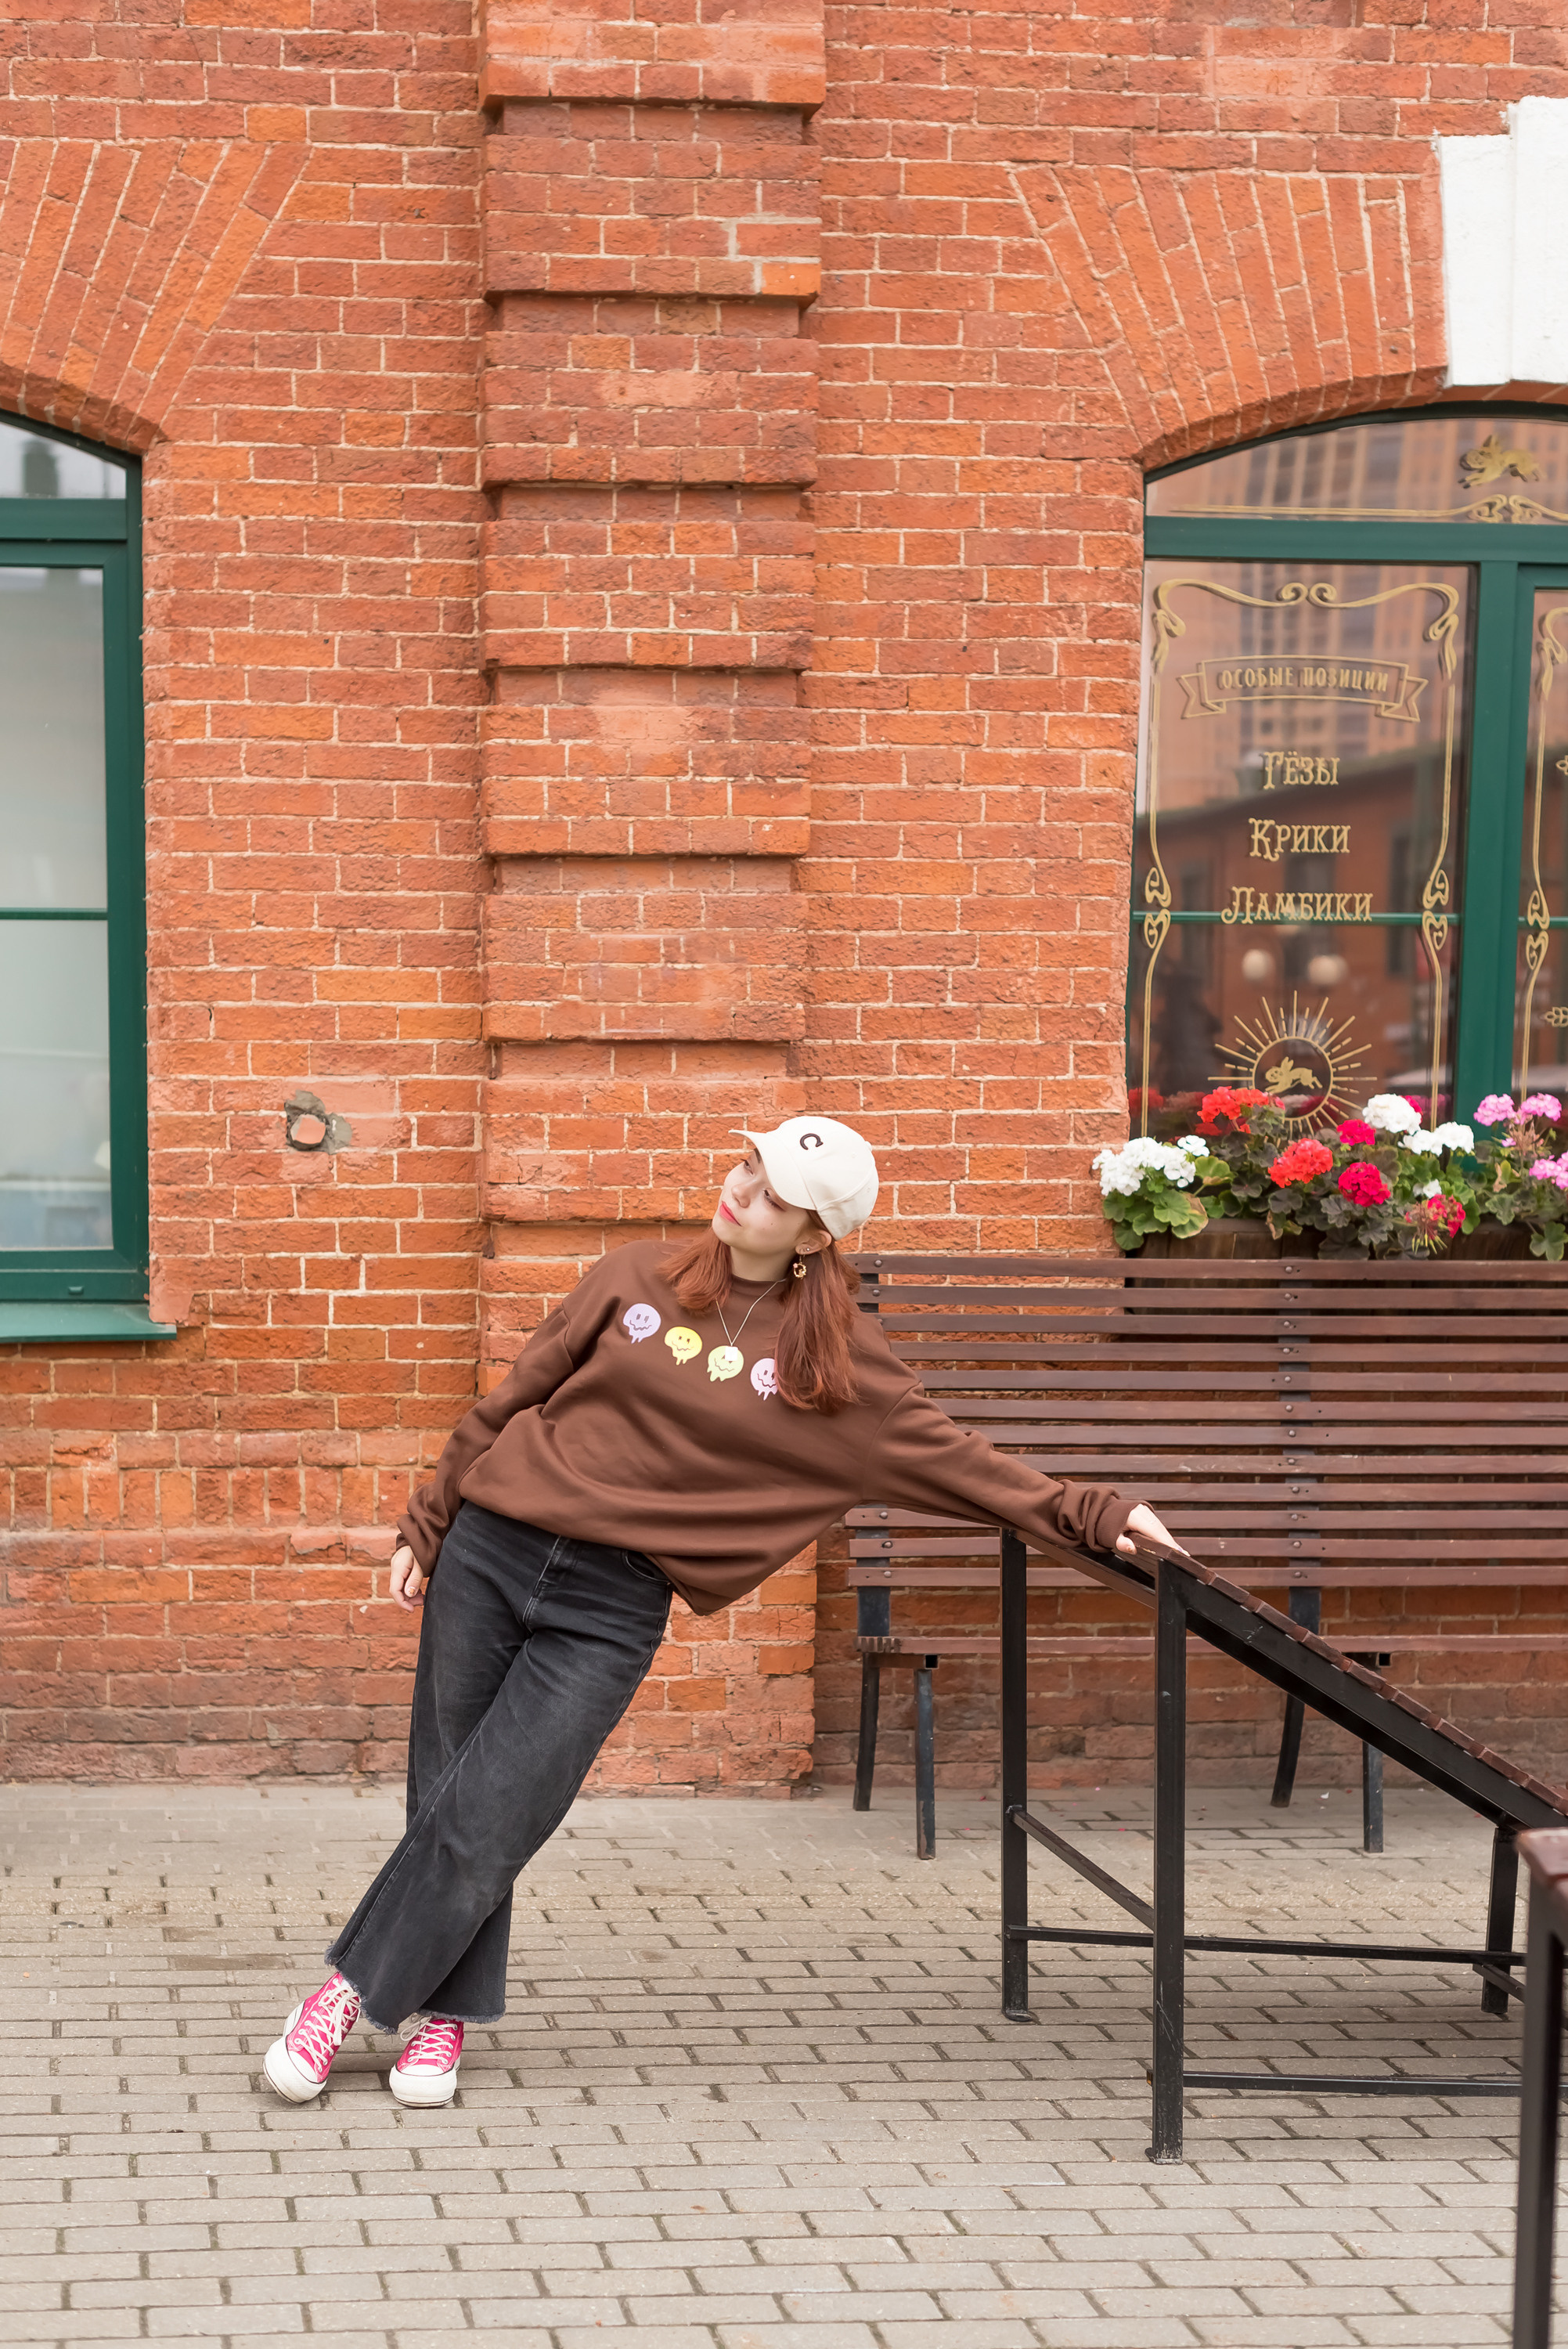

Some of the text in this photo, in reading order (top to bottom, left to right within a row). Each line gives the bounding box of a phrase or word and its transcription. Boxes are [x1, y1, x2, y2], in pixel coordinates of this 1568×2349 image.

[1221, 667, 1389, 692] ОСОБЫЕ ПОЗИЦИИ
[1263, 751, 1340, 790] ГЁЗЫ
[1248, 817, 1351, 862] КРИКИ
[1220, 886, 1374, 925] ЛАМБИКИ
[799, 1132, 824, 1151] C
